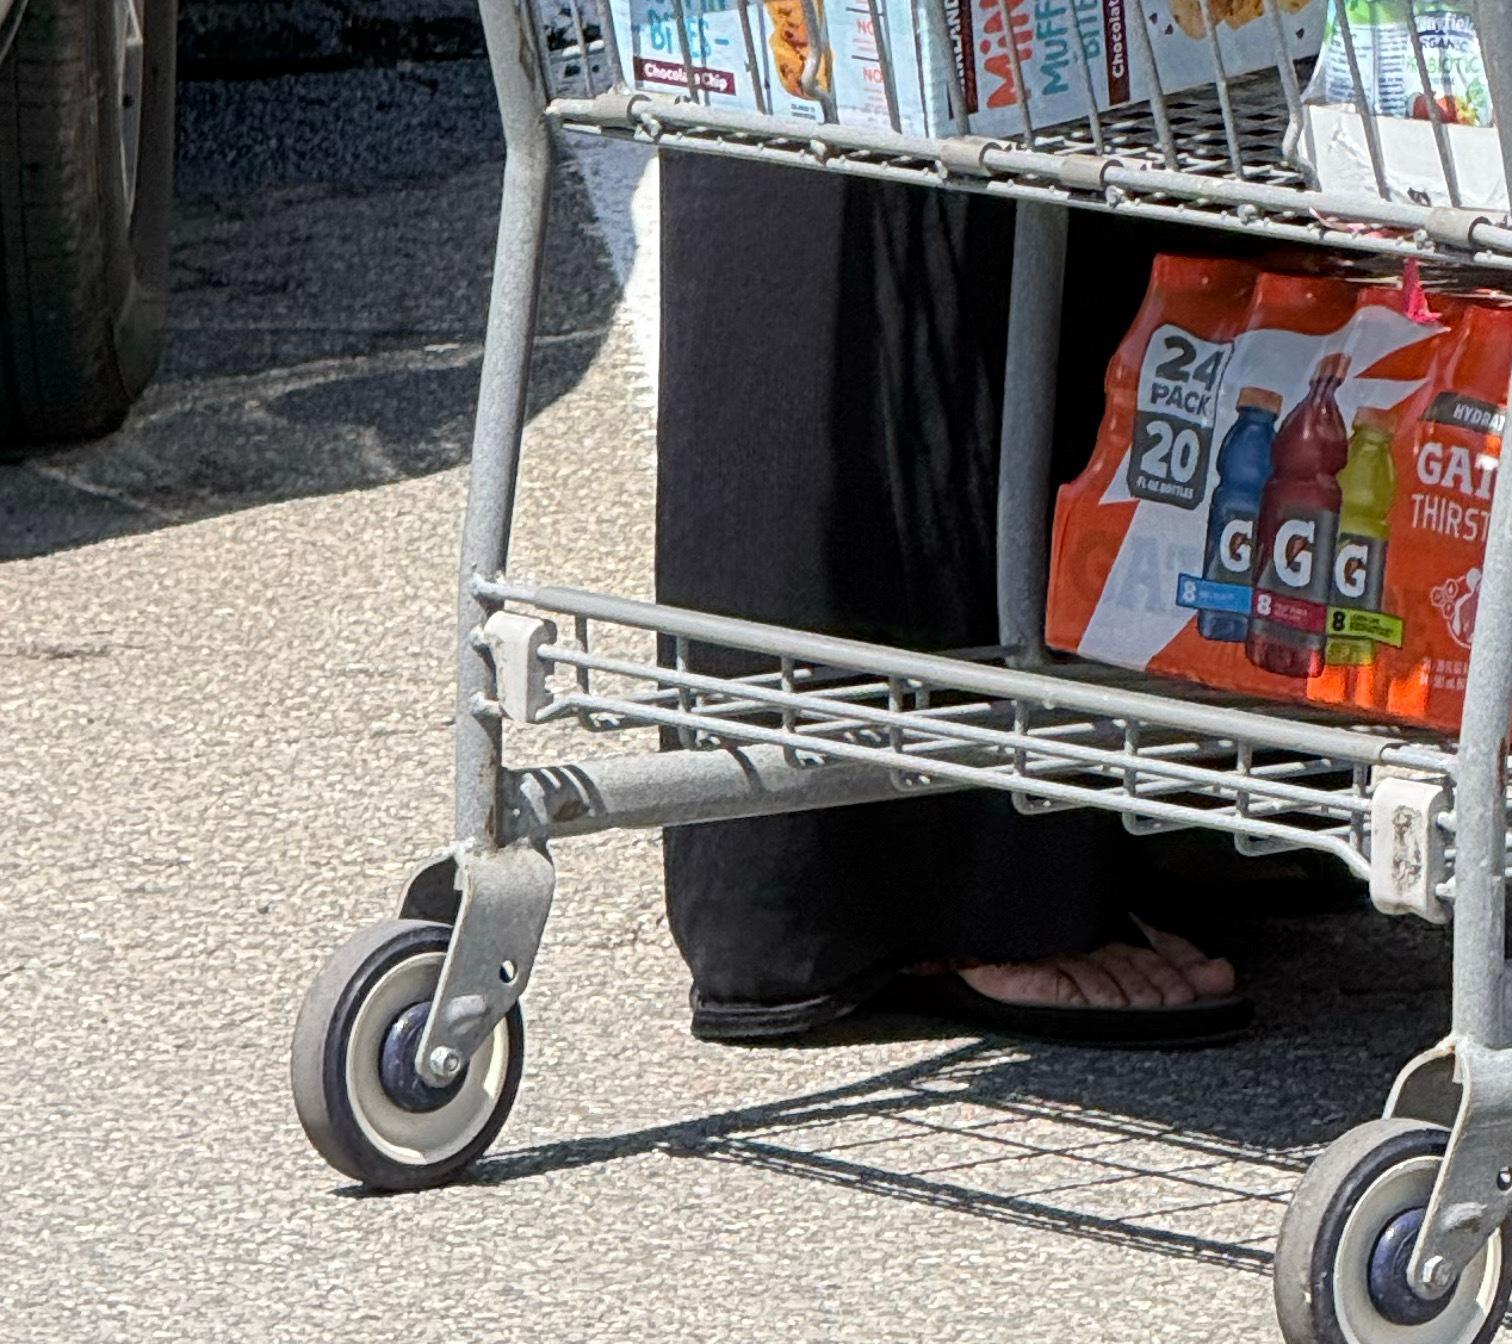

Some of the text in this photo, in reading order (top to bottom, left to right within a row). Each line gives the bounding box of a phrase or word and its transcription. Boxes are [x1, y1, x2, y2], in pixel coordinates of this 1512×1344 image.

[1155, 335, 1224, 392] 24
[1150, 382, 1213, 417] PACK
[1140, 420, 1201, 484] 20
[1220, 518, 1253, 573] G
[1273, 518, 1316, 588] G
[1335, 543, 1369, 599] G
[1182, 579, 1197, 604] 8
[1256, 592, 1272, 617] 8
[1332, 610, 1346, 632] 8
